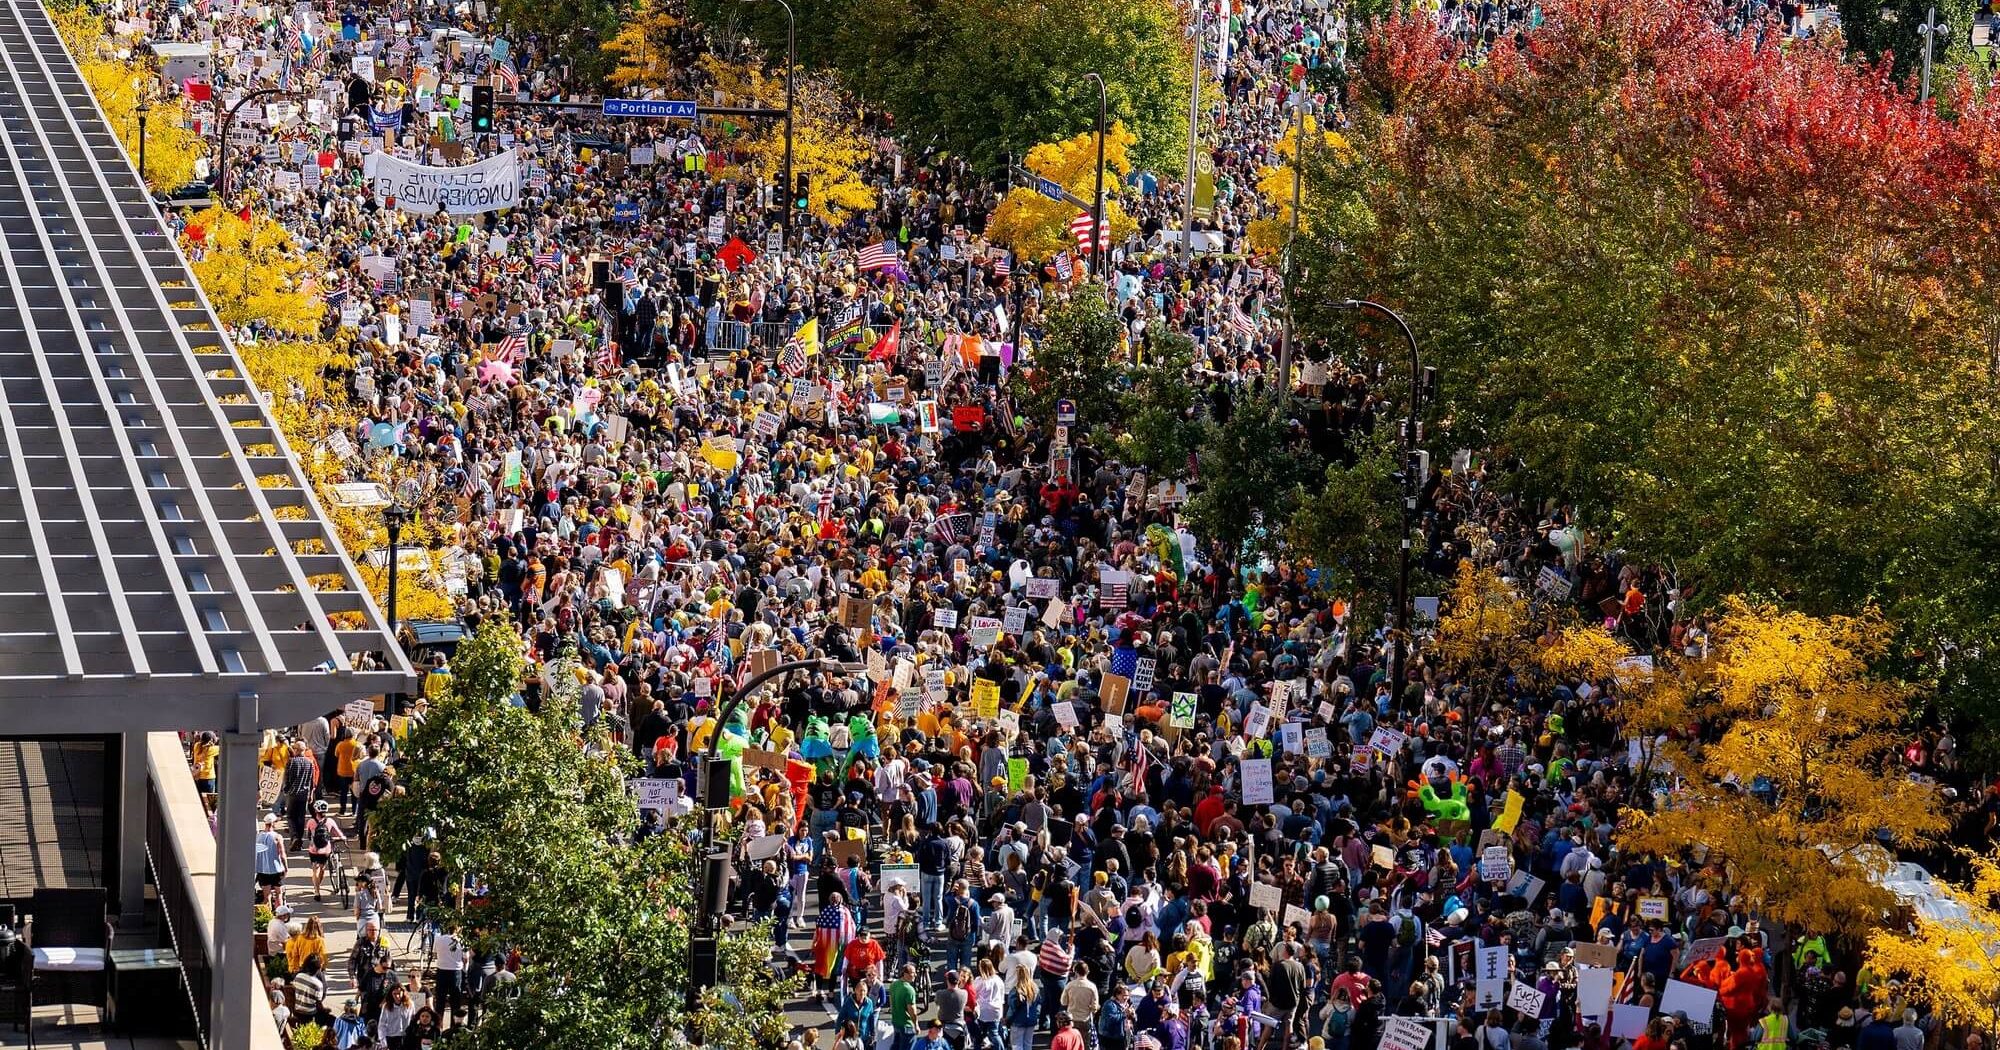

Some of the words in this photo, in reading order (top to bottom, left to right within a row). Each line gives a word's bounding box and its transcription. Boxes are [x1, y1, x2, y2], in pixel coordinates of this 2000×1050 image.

[621, 103, 672, 113] Portland
[678, 105, 693, 114] Av
[978, 620, 996, 628] LOVE
[263, 771, 280, 779] HEY
[260, 780, 279, 789] GOP
[1515, 985, 1541, 1007] FUCK
[1513, 998, 1538, 1015] ICE
[1396, 1020, 1409, 1029] THEY
[1394, 1028, 1424, 1043] IMMIGRANTS
